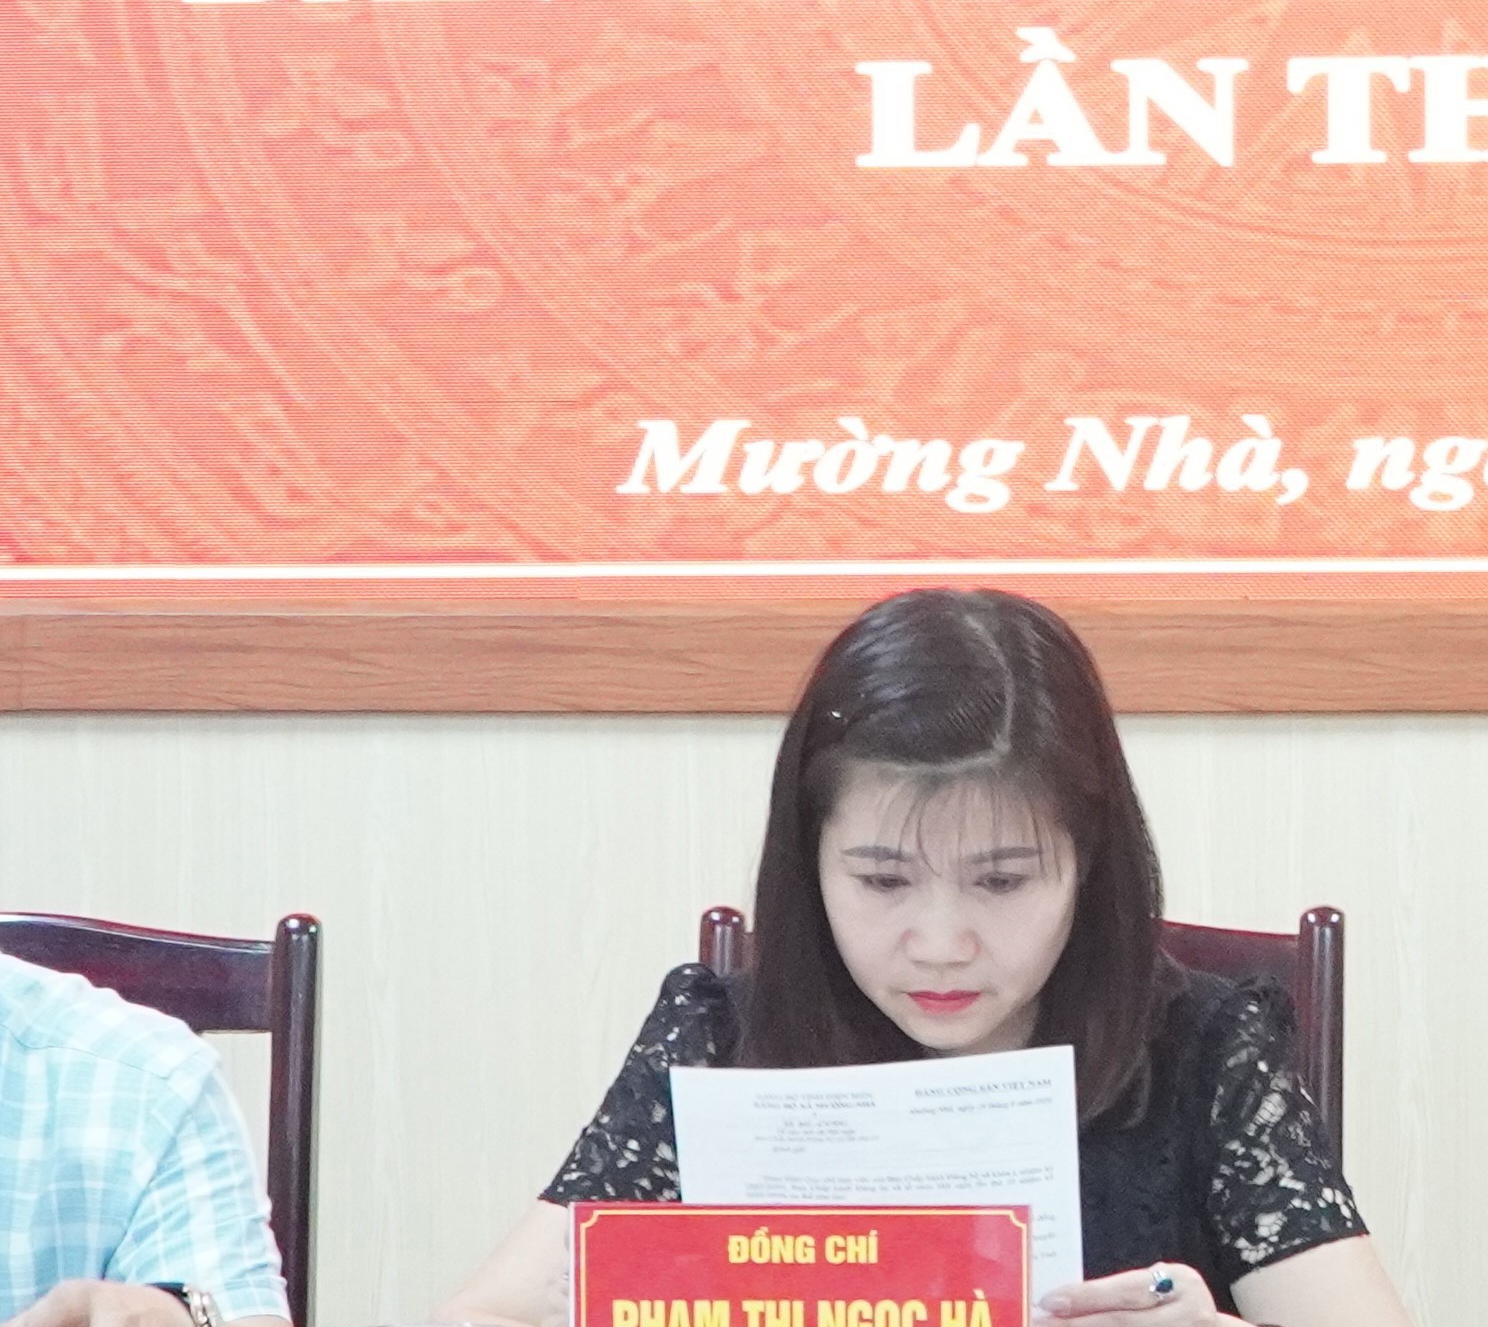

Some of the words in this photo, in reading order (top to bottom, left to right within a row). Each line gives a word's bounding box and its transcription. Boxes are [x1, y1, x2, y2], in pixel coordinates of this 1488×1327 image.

[854, 25, 1249, 168] LẦN
[616, 416, 1025, 513] Mường
[1044, 414, 1309, 505] Nhà,
[727, 1226, 816, 1264] ĐỒNG
[824, 1229, 878, 1264] CHÍ
